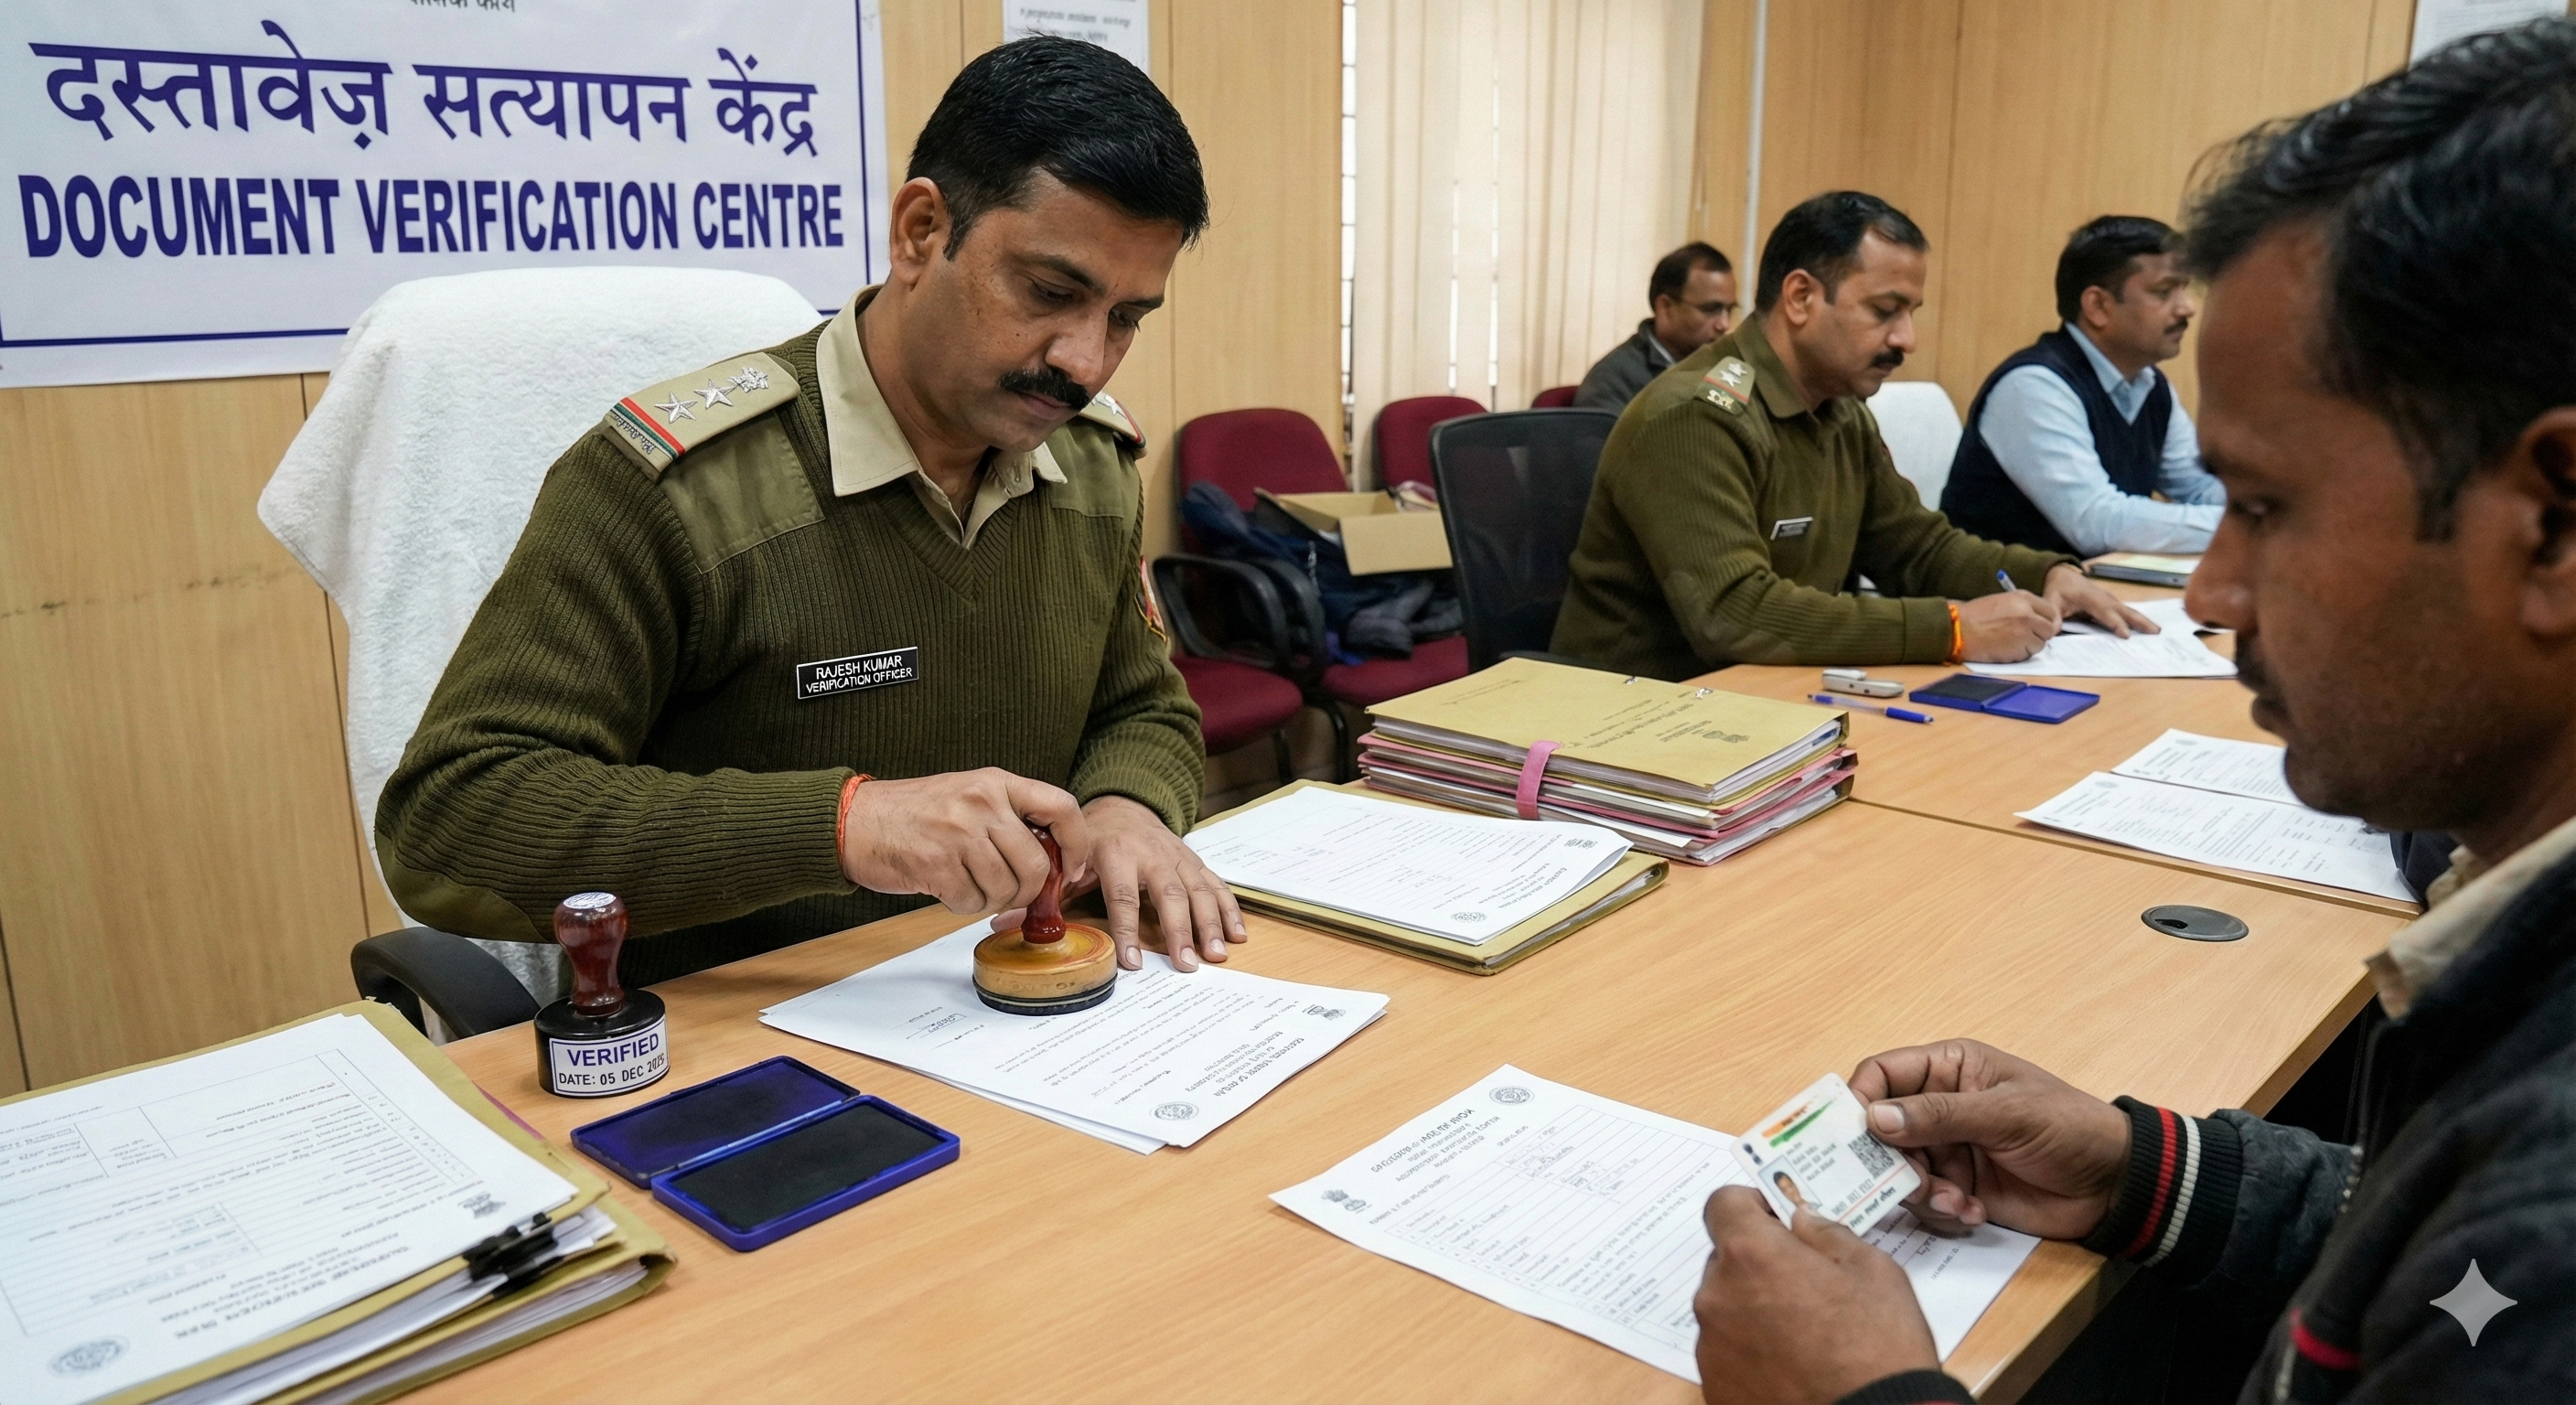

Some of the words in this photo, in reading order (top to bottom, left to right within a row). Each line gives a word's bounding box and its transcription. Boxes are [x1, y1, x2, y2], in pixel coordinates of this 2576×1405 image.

[27, 20, 392, 151] दस्तावेज़
[413, 64, 691, 145] सत्यापन
[709, 48, 818, 156] केंद्र
[18, 175, 340, 259] DOCUMENT
[355, 179, 681, 254] VERIFICATION
[692, 183, 843, 251] CENTRE
[806, 674, 871, 693] VERIFICATION
[873, 667, 913, 683] OFFICER
[816, 661, 861, 680] RAJESH
[863, 655, 903, 672] KUMAR
[567, 1033, 659, 1067] VERIFIED
[559, 1072, 596, 1086] DATE:
[600, 1072, 616, 1086] 05
[622, 1065, 644, 1082] DEC
